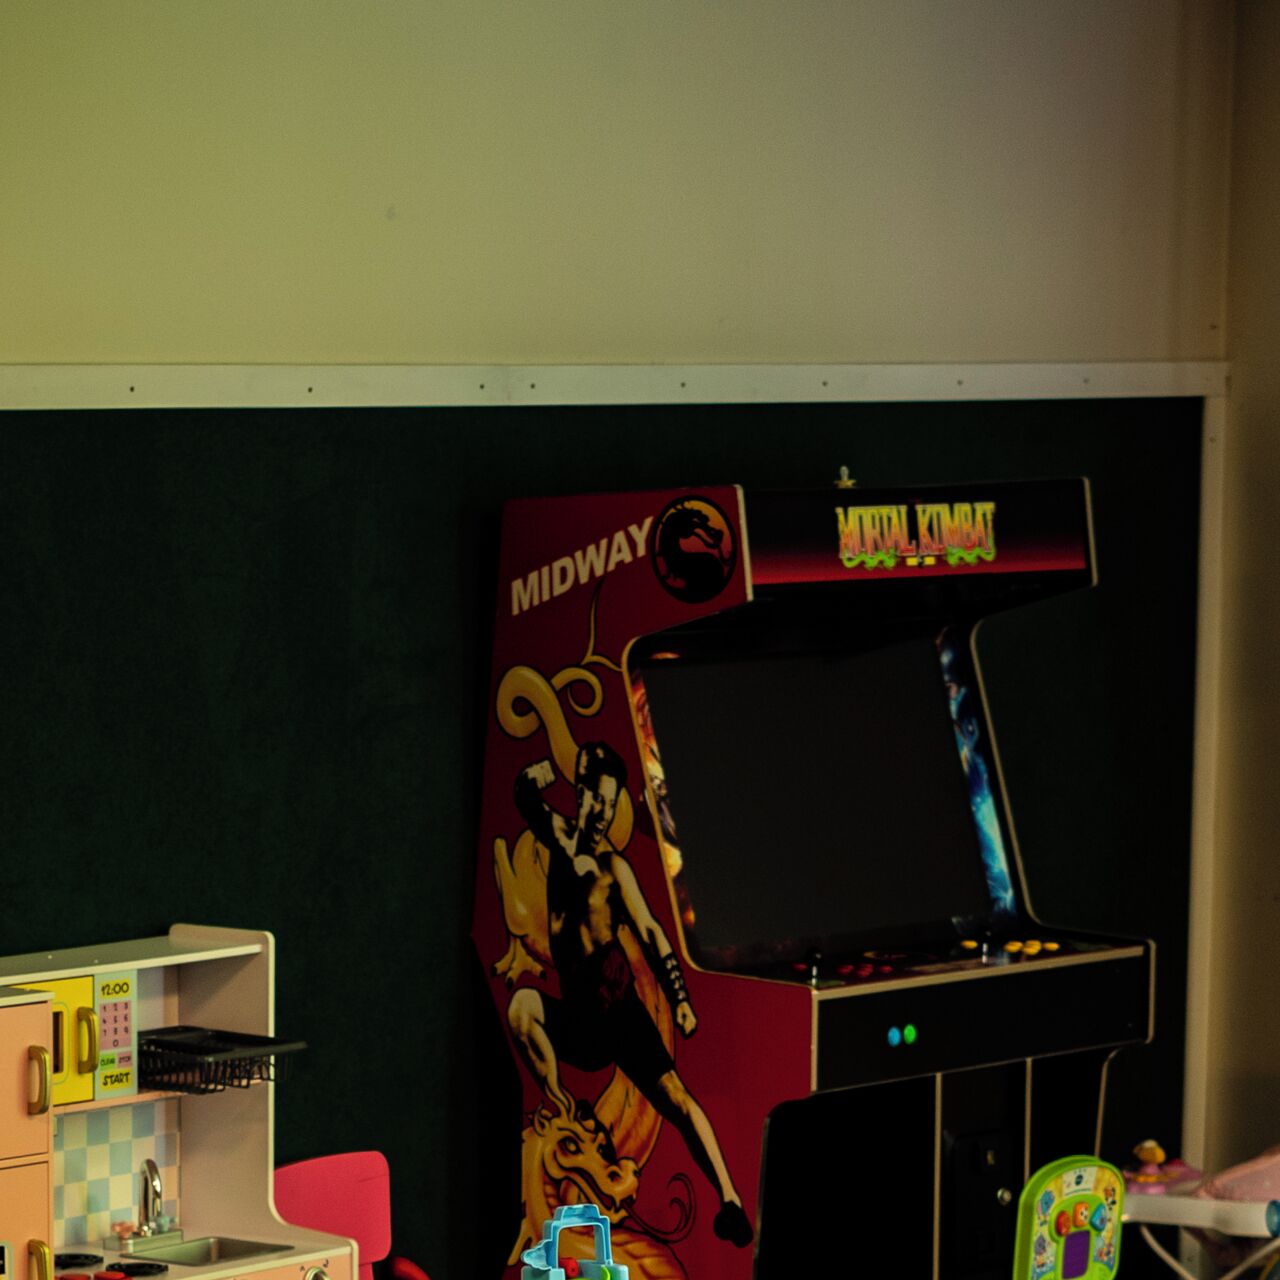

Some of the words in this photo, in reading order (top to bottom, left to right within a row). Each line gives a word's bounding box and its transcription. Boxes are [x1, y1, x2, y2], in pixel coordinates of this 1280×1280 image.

[835, 504, 916, 559] MORTAL
[915, 502, 996, 556] KOMBAT
[511, 515, 654, 617] MIDWAY
[103, 1072, 130, 1086] START
